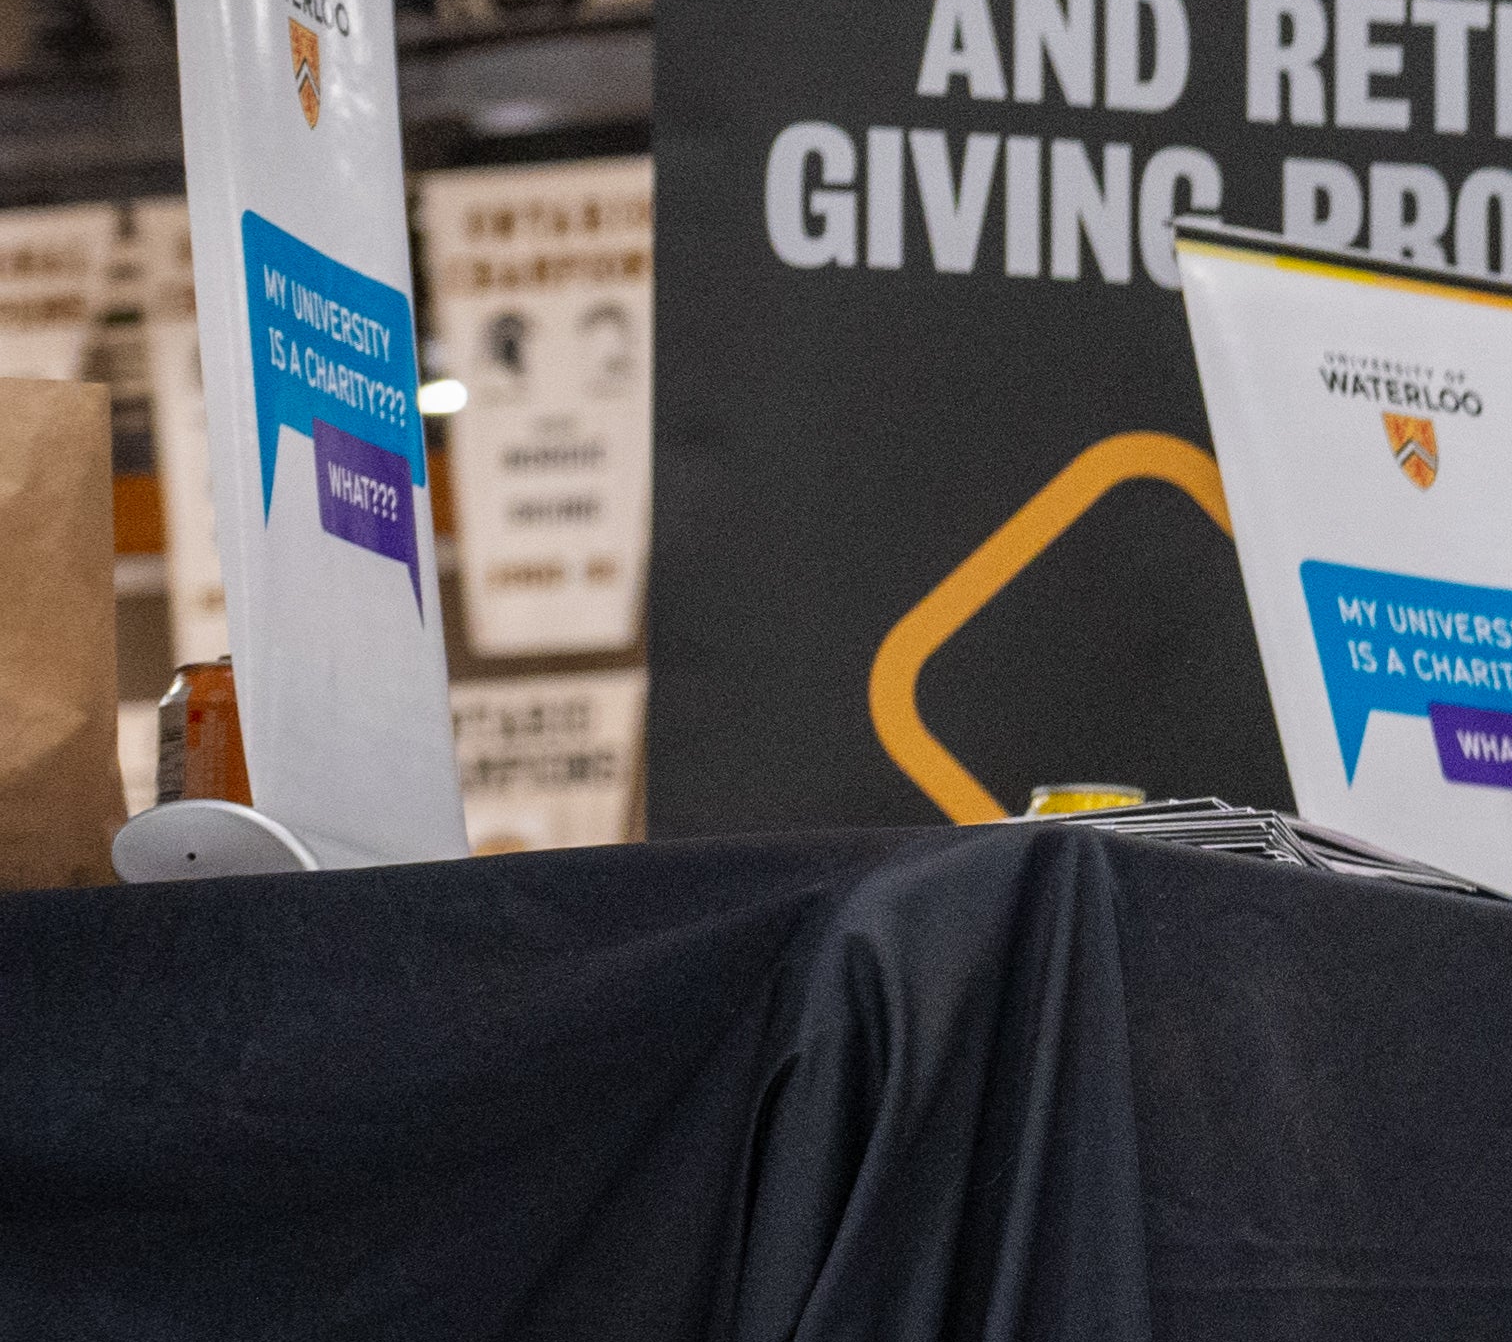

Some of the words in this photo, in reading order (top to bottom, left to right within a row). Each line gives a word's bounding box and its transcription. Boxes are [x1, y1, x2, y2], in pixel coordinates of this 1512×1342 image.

[263, 263, 287, 310] MY
[290, 279, 391, 364] UNIVERSITY
[268, 326, 287, 371] IS
[289, 340, 302, 380] A
[304, 346, 407, 428] CHARITY???
[1319, 365, 1483, 417] WATERLOO
[327, 460, 399, 522] WHAT???
[1336, 595, 1378, 628] MY
[1347, 639, 1378, 675] IS
[1387, 646, 1407, 677] A
